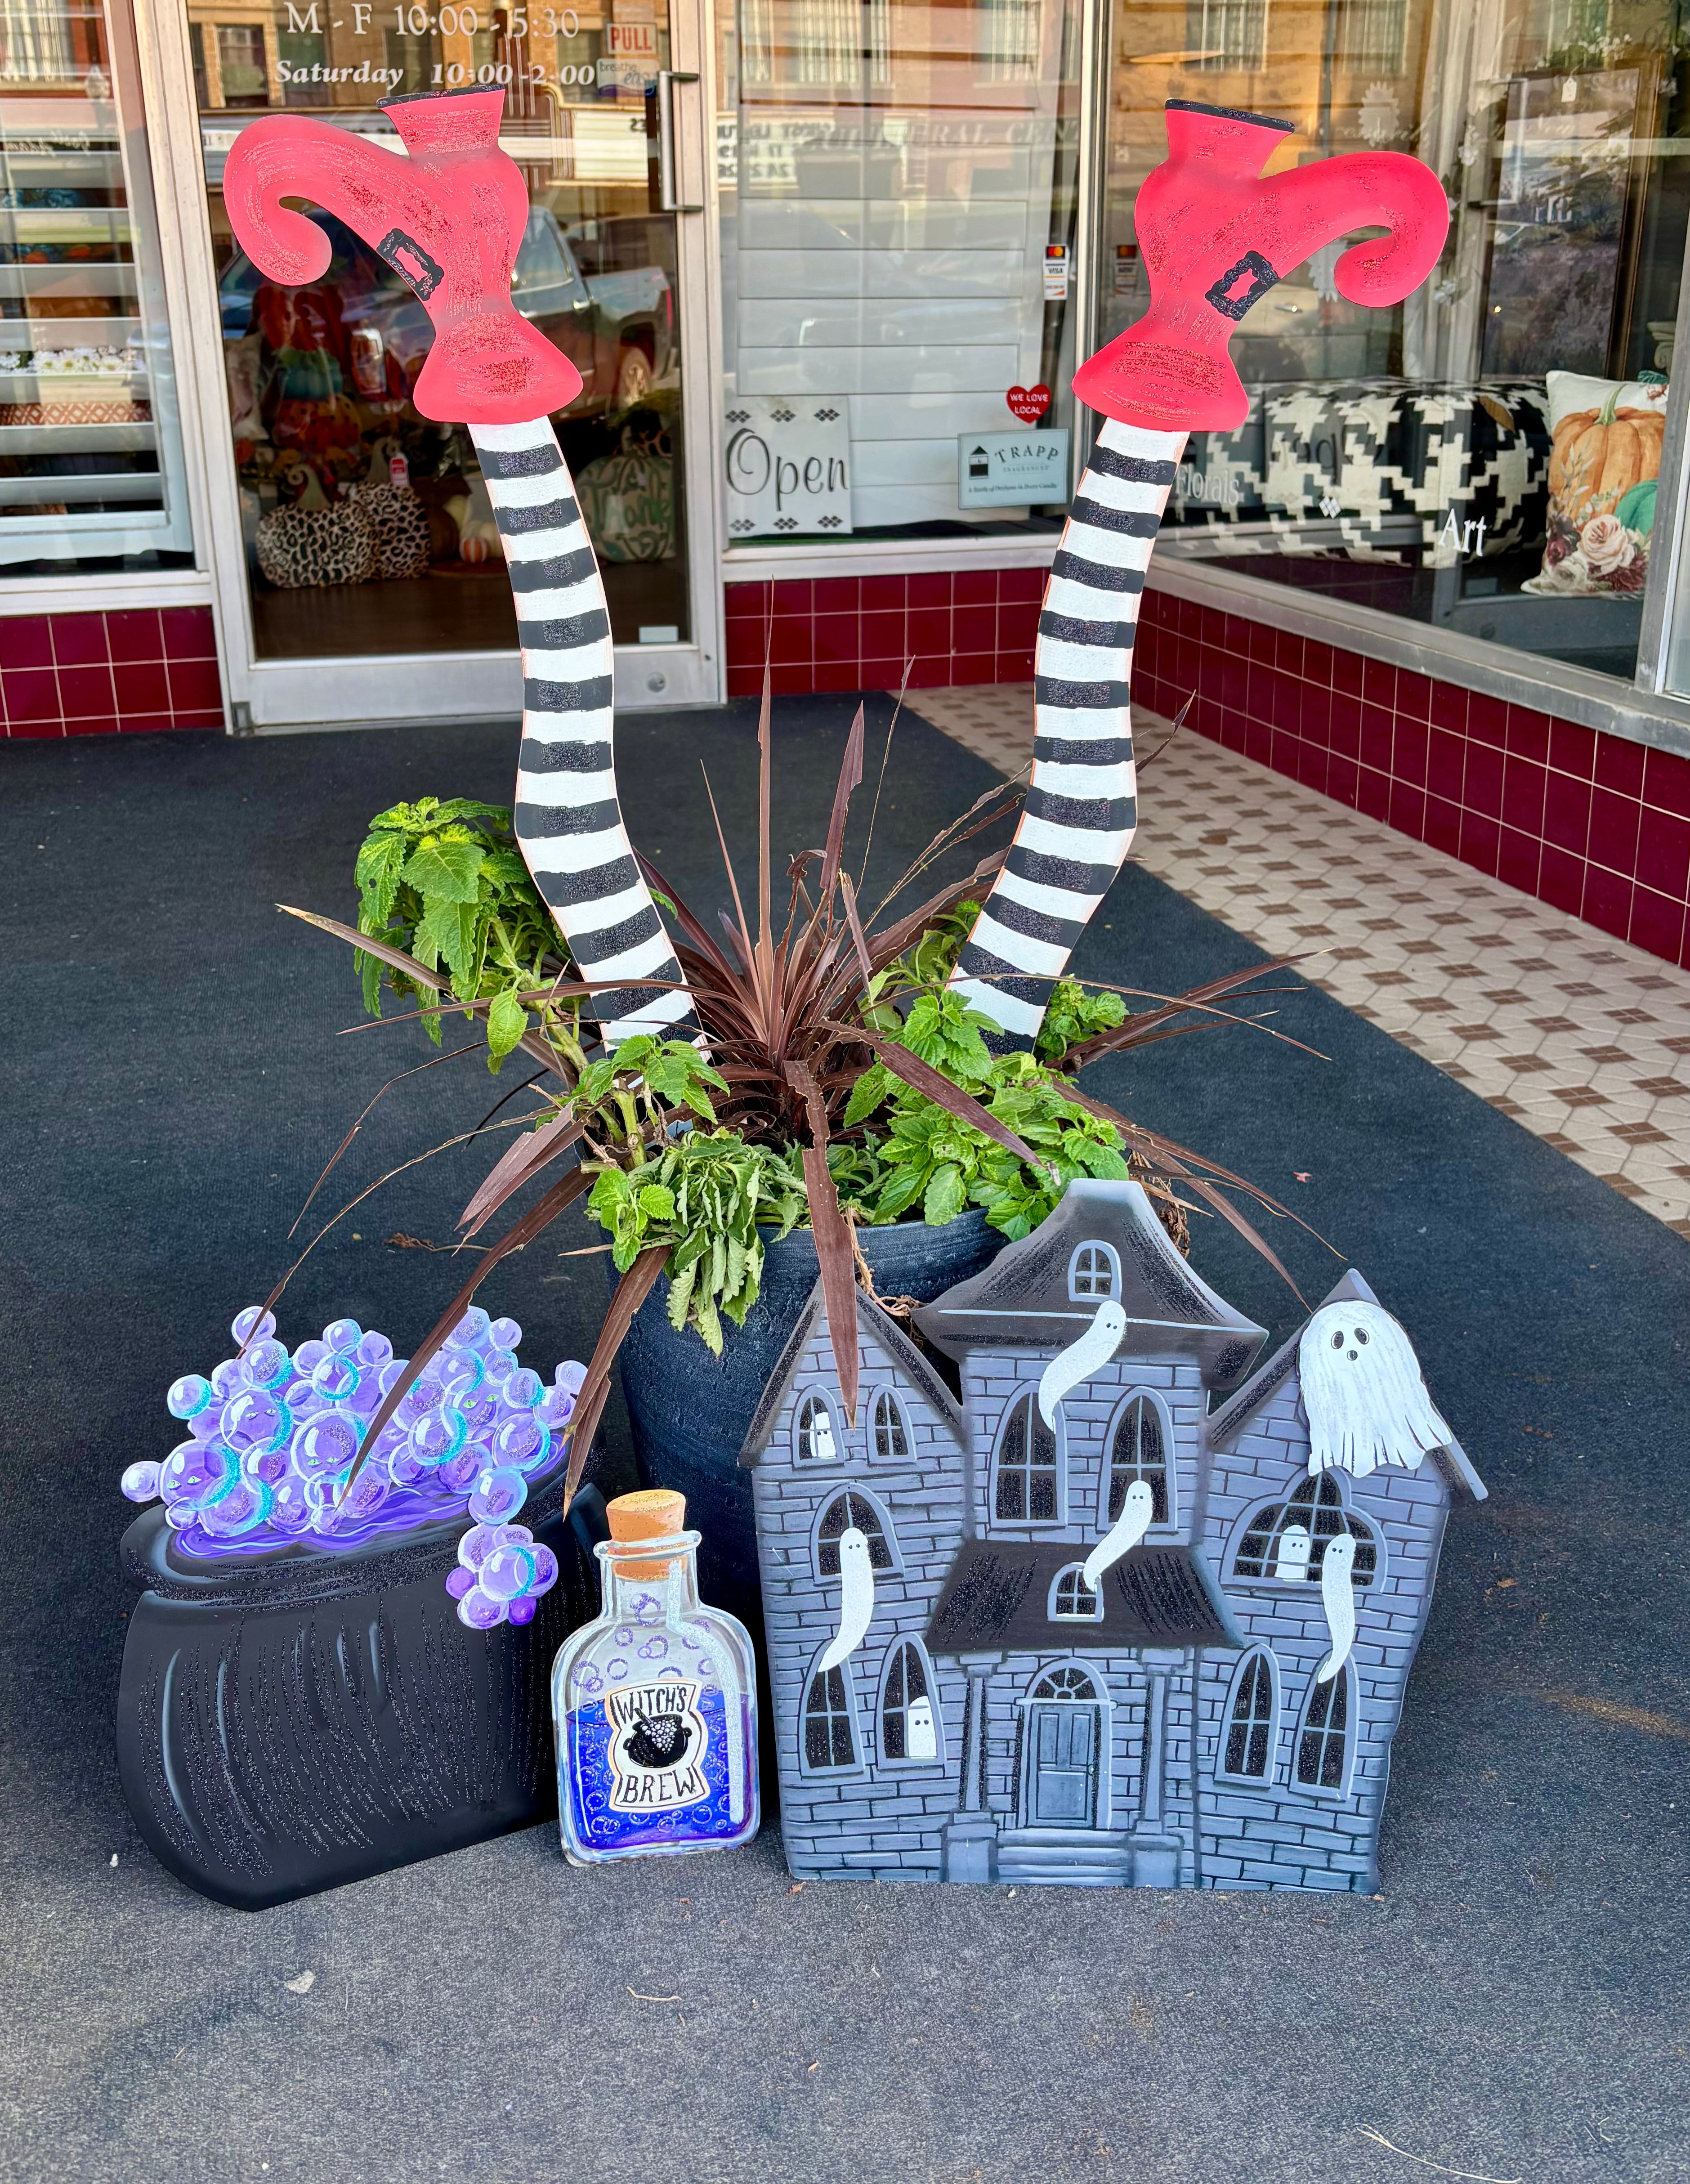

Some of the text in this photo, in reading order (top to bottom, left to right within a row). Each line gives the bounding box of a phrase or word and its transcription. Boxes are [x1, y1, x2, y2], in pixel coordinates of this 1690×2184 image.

[283, 1, 323, 34] M
[333, 20, 344, 28] -
[351, 3, 372, 35] F
[394, 5, 478, 36] 10:00
[512, 7, 579, 38] 5:30
[611, 27, 653, 51] PULL
[274, 60, 404, 90] Saturday
[1010, 394, 1049, 402] WE LOVE
[1015, 406, 1042, 414] LOCAL
[726, 428, 849, 512] Open
[994, 445, 1059, 463] TRAPP
[1175, 465, 1240, 506] Florals
[1437, 508, 1487, 557] Art
[614, 1685, 687, 1725] WITCH'S
[620, 1767, 695, 1803] BREW
